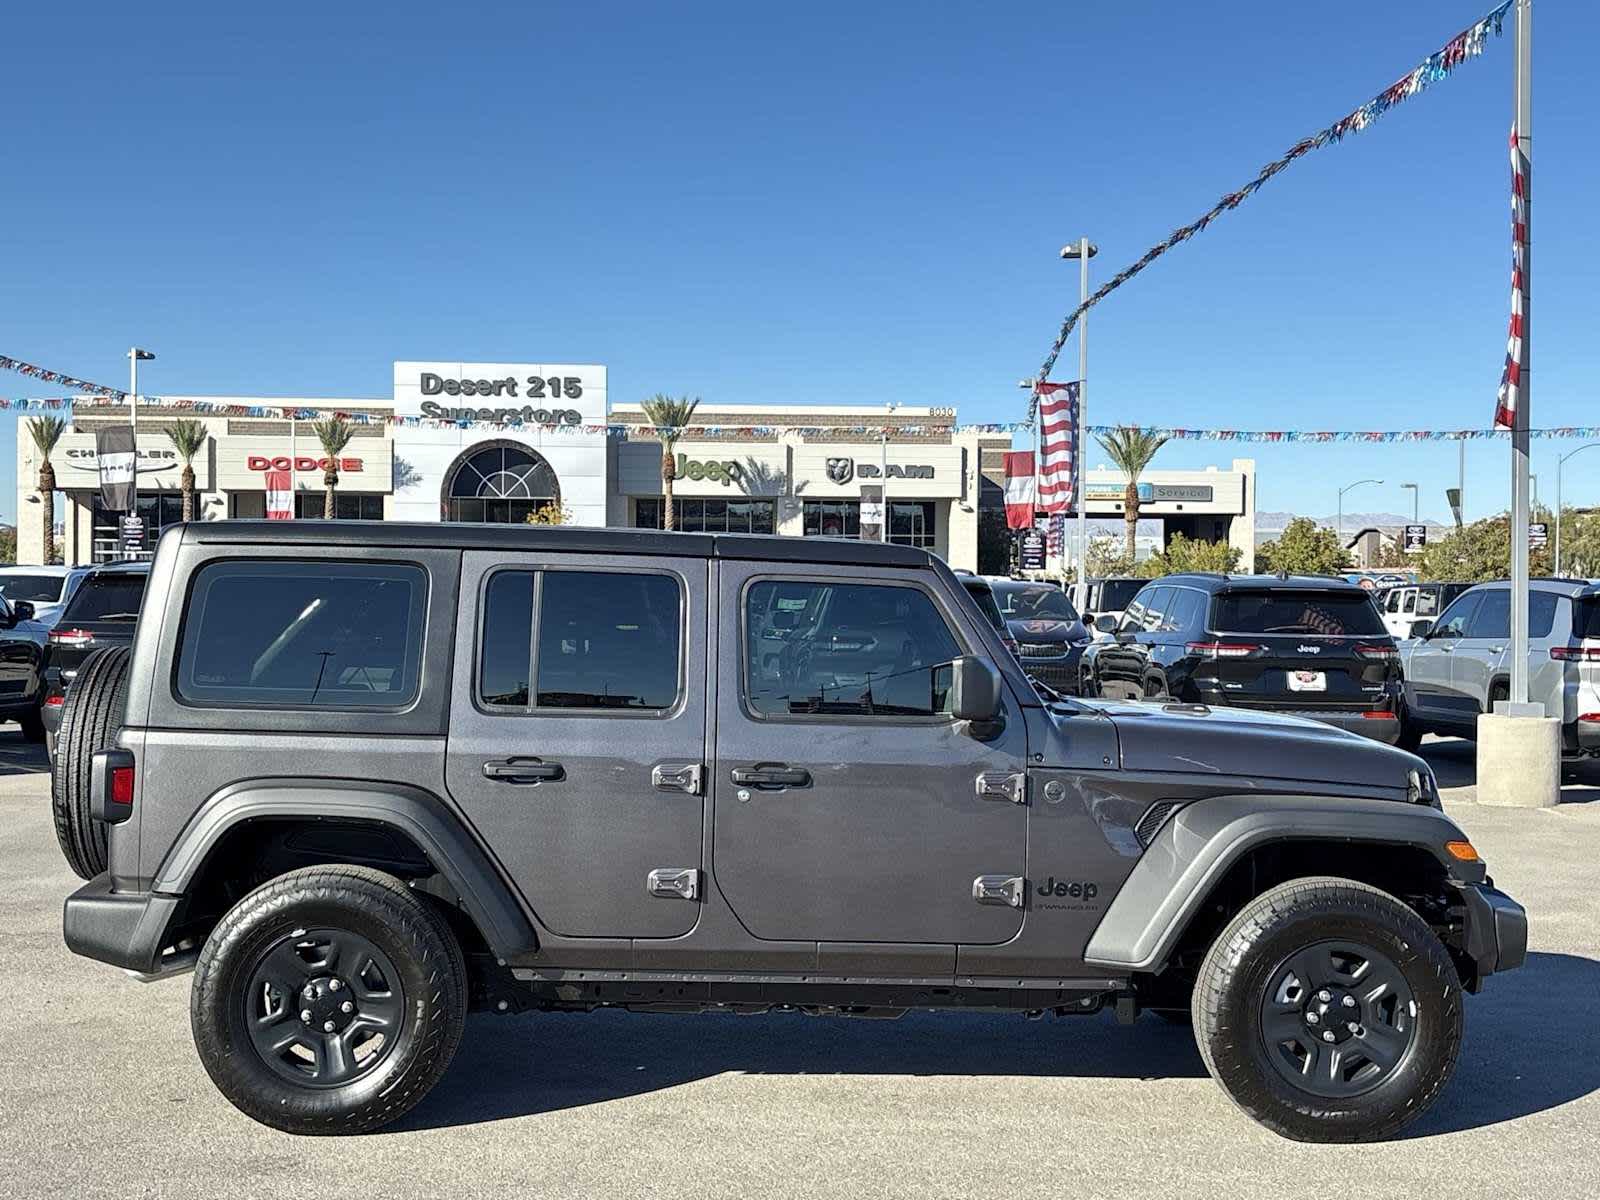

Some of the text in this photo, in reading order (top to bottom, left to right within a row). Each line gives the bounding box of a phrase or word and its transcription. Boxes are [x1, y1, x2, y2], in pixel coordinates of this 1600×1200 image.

[420, 372, 582, 399] Desert 215
[929, 407, 953, 417] 8030
[66, 448, 176, 459] CHLER
[673, 453, 741, 487] Jeep
[857, 464, 935, 479] RAM
[1158, 487, 1205, 497] Service
[1297, 644, 1321, 655] Jeep
[1037, 876, 1098, 901] Jeep
